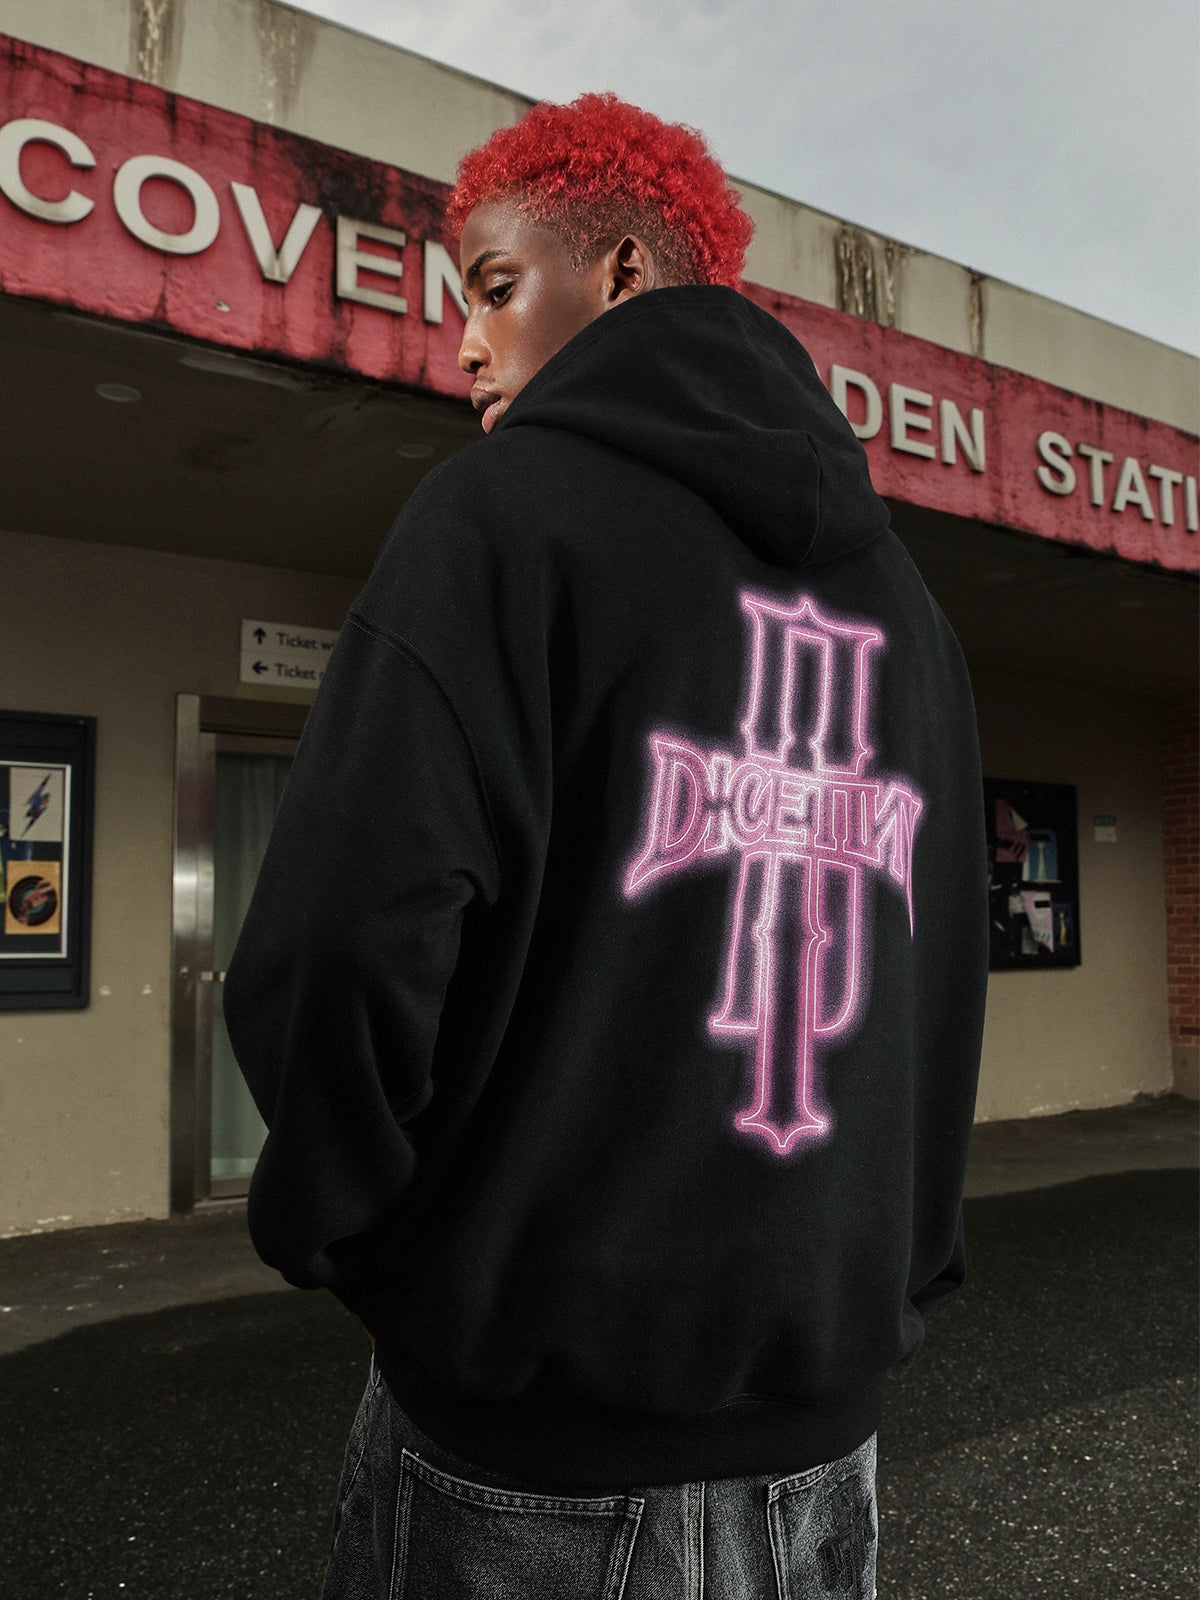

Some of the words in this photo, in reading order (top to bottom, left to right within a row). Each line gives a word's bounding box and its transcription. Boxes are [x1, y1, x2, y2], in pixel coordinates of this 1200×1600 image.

[0, 118, 469, 324] COVEN
[1036, 431, 1198, 532] STATI
[276, 631, 317, 649] Ticket
[274, 662, 316, 681] Ticket
